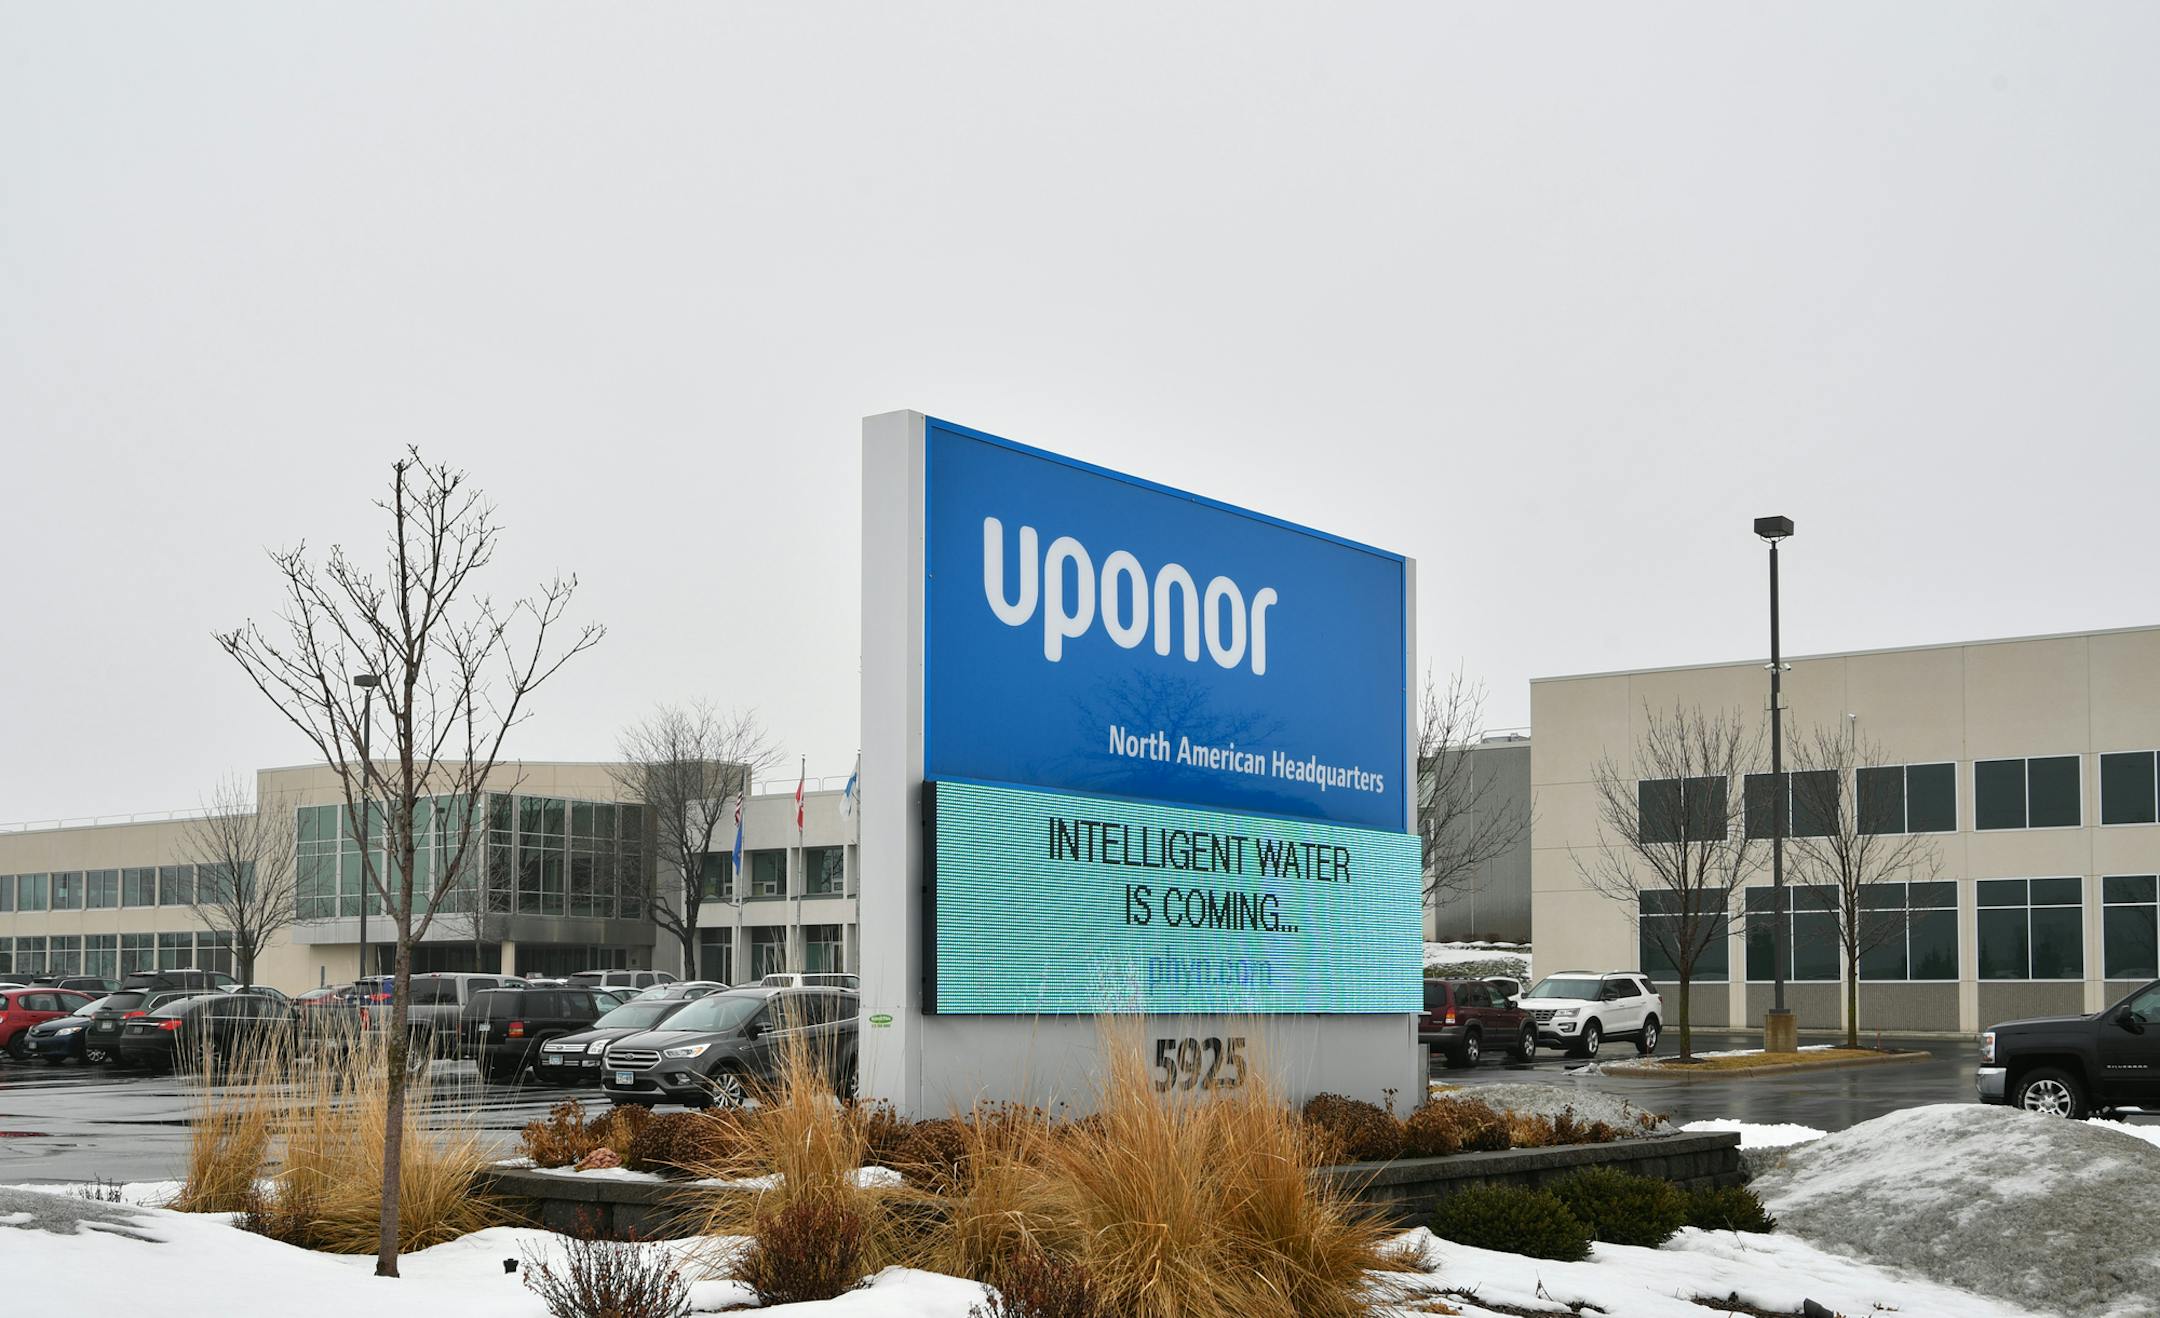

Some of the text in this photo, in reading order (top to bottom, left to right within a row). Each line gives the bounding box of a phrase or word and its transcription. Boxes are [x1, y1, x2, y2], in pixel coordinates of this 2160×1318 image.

[983, 516, 1278, 676] uponor
[1108, 725, 1385, 794] North American Headquarters
[1050, 816, 1350, 883] INTELLIGENT WATER
[1125, 884, 1299, 933] IS COMING...
[1148, 944, 1274, 997] phyn.com
[1154, 1036, 1247, 1094] 5925
